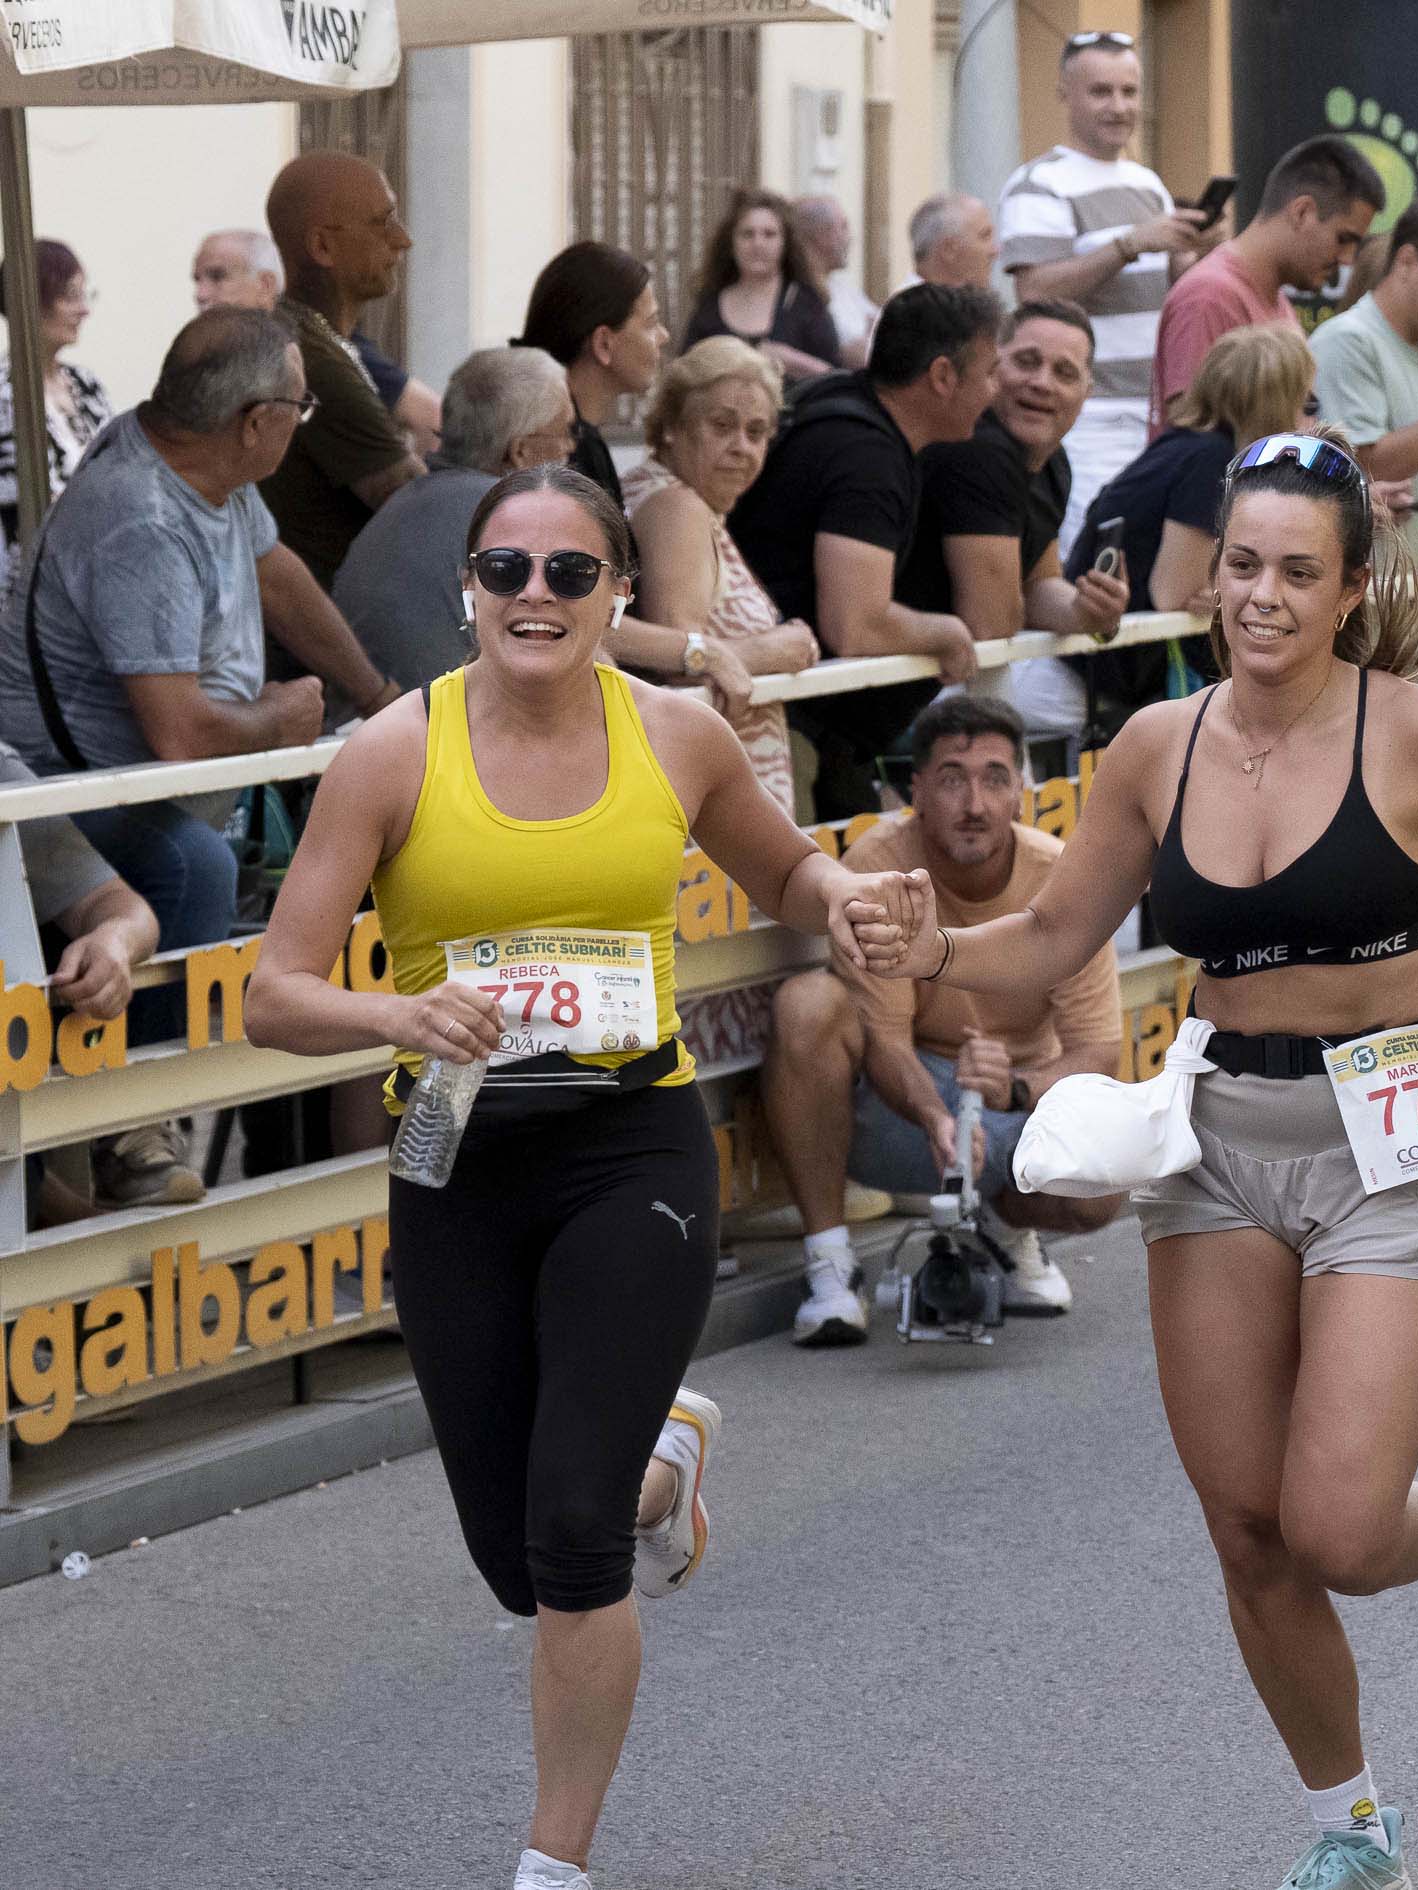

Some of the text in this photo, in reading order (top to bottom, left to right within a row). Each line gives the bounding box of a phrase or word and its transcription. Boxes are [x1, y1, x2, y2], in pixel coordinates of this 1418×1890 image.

[505, 942, 626, 958] CELTIC SUBMARÍ
[1350, 932, 1408, 959] NIKE
[1236, 945, 1289, 970] NIKE
[499, 965, 560, 980] REBECA
[477, 980, 582, 1029] 778
[500, 1034, 570, 1054] OVALCA
